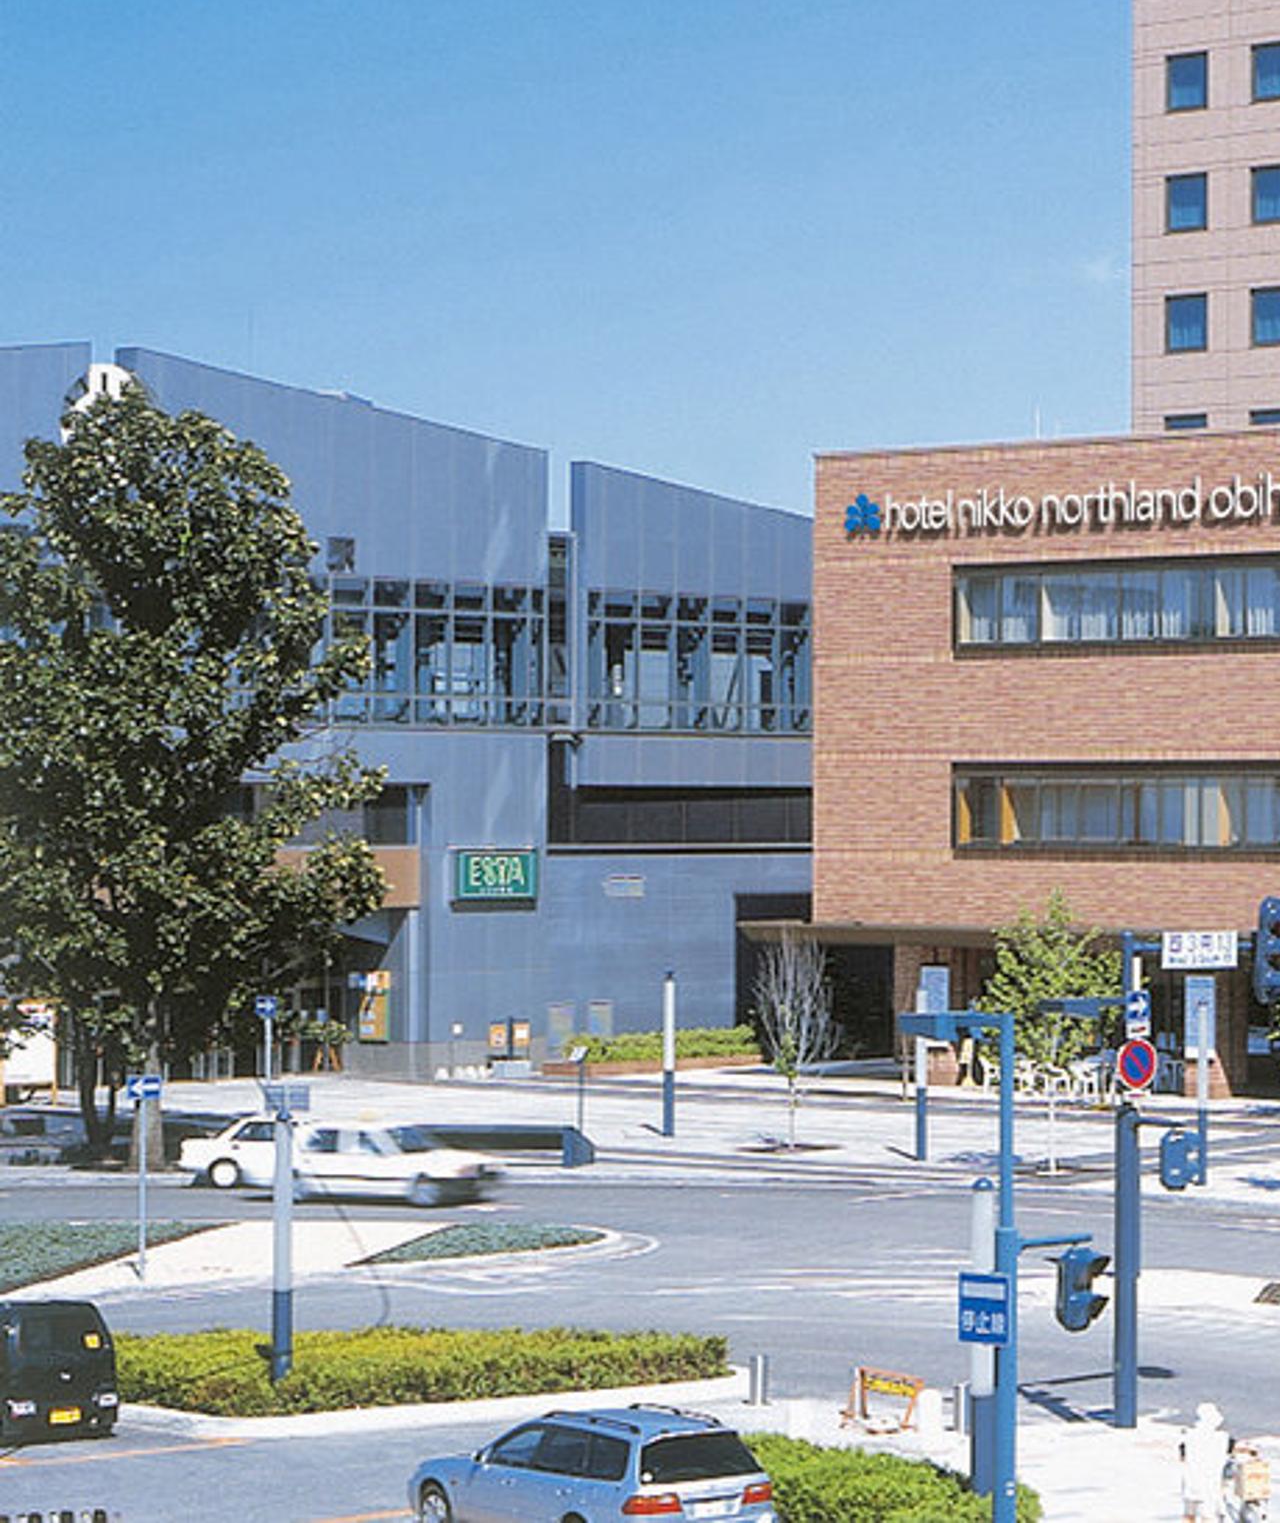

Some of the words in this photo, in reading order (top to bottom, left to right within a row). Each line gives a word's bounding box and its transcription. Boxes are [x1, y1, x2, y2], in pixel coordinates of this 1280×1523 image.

[883, 489, 954, 532] hotel
[958, 487, 1034, 528] nikko
[1041, 477, 1201, 526] northland
[468, 856, 526, 887] ESTA
